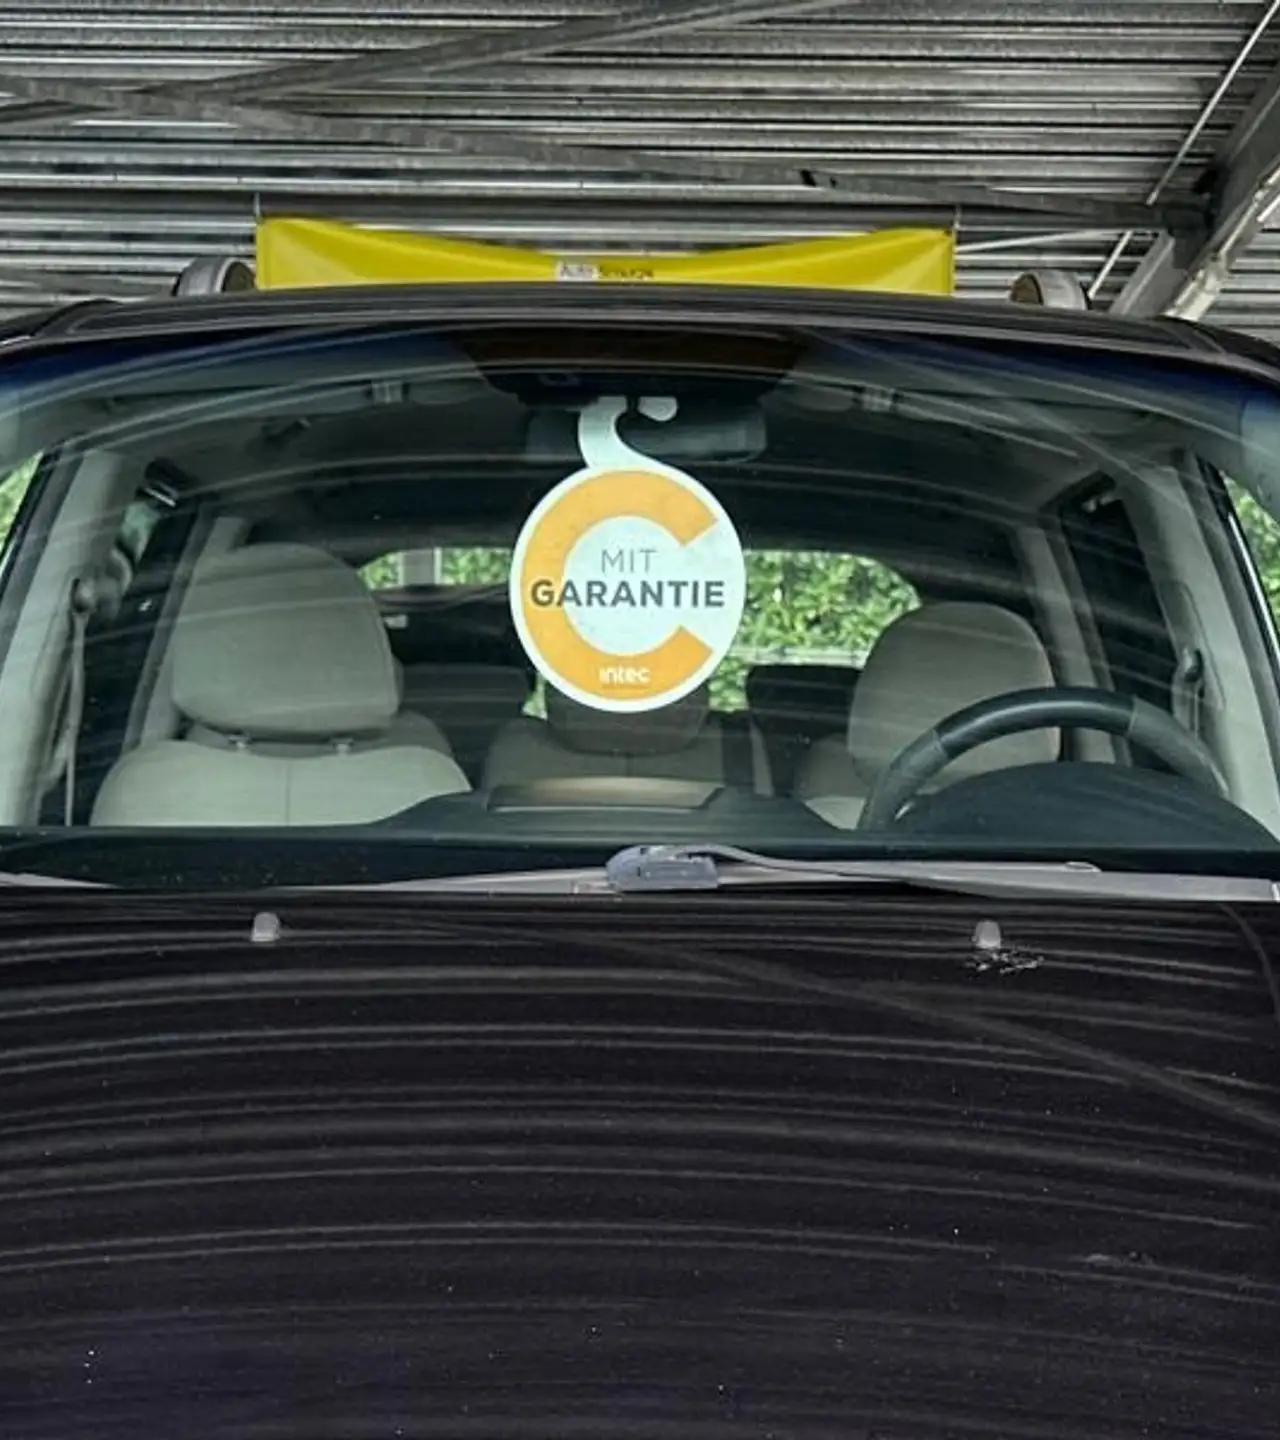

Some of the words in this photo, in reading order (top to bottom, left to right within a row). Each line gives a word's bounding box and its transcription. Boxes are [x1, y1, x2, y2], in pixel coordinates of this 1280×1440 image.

[601, 549, 656, 574] MIT
[531, 579, 725, 608] GARANTIE
[599, 665, 651, 685] intec
